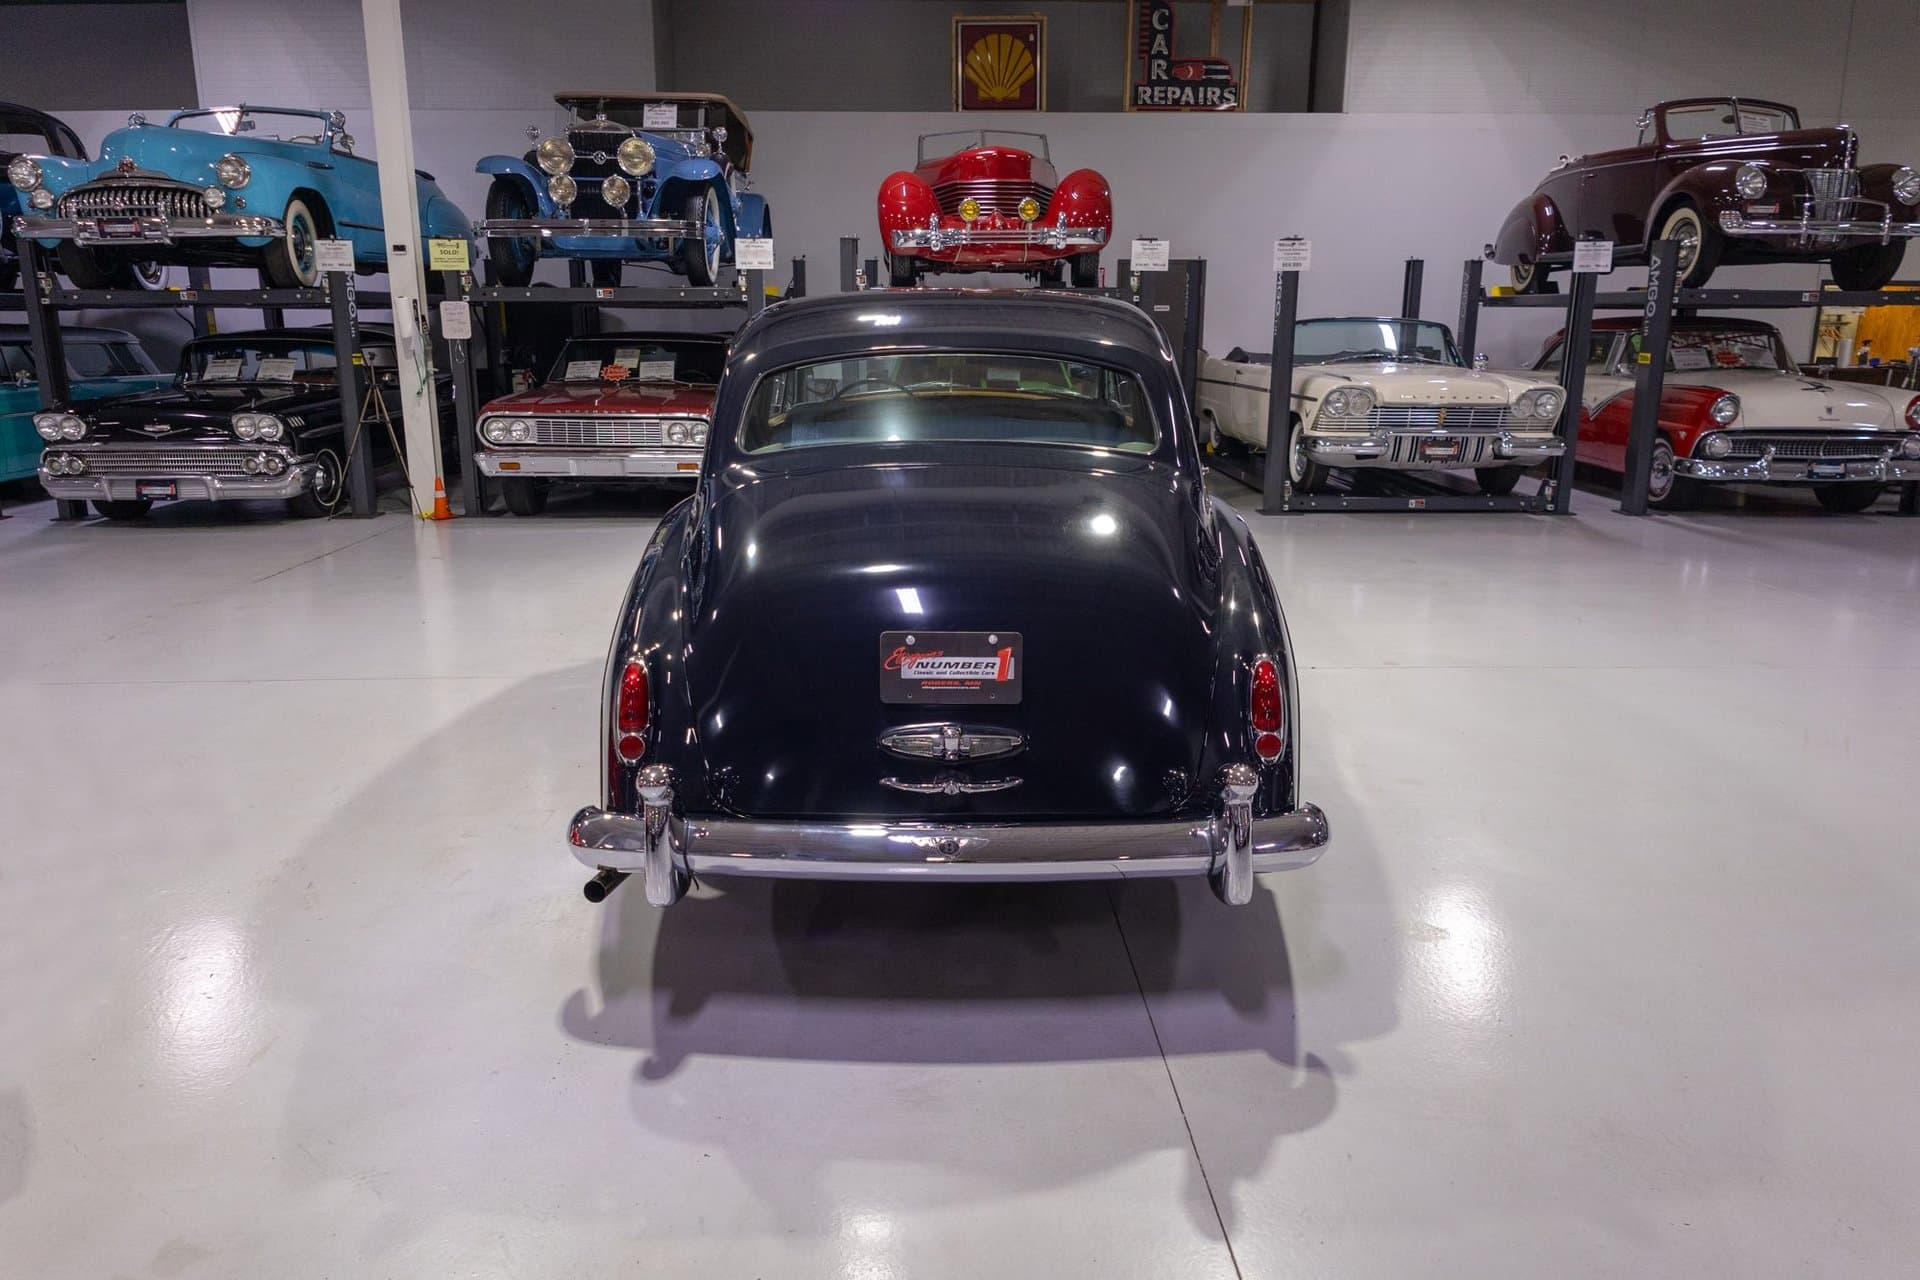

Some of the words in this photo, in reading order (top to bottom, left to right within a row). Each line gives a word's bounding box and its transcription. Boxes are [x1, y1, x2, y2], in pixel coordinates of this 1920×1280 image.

[1152, 8, 1169, 80] CAR
[1138, 86, 1236, 105] REPAIRS
[345, 271, 357, 318] MGO
[1646, 255, 1660, 317] AMGO
[915, 661, 997, 669] NUMBER
[997, 647, 1012, 682] 1
